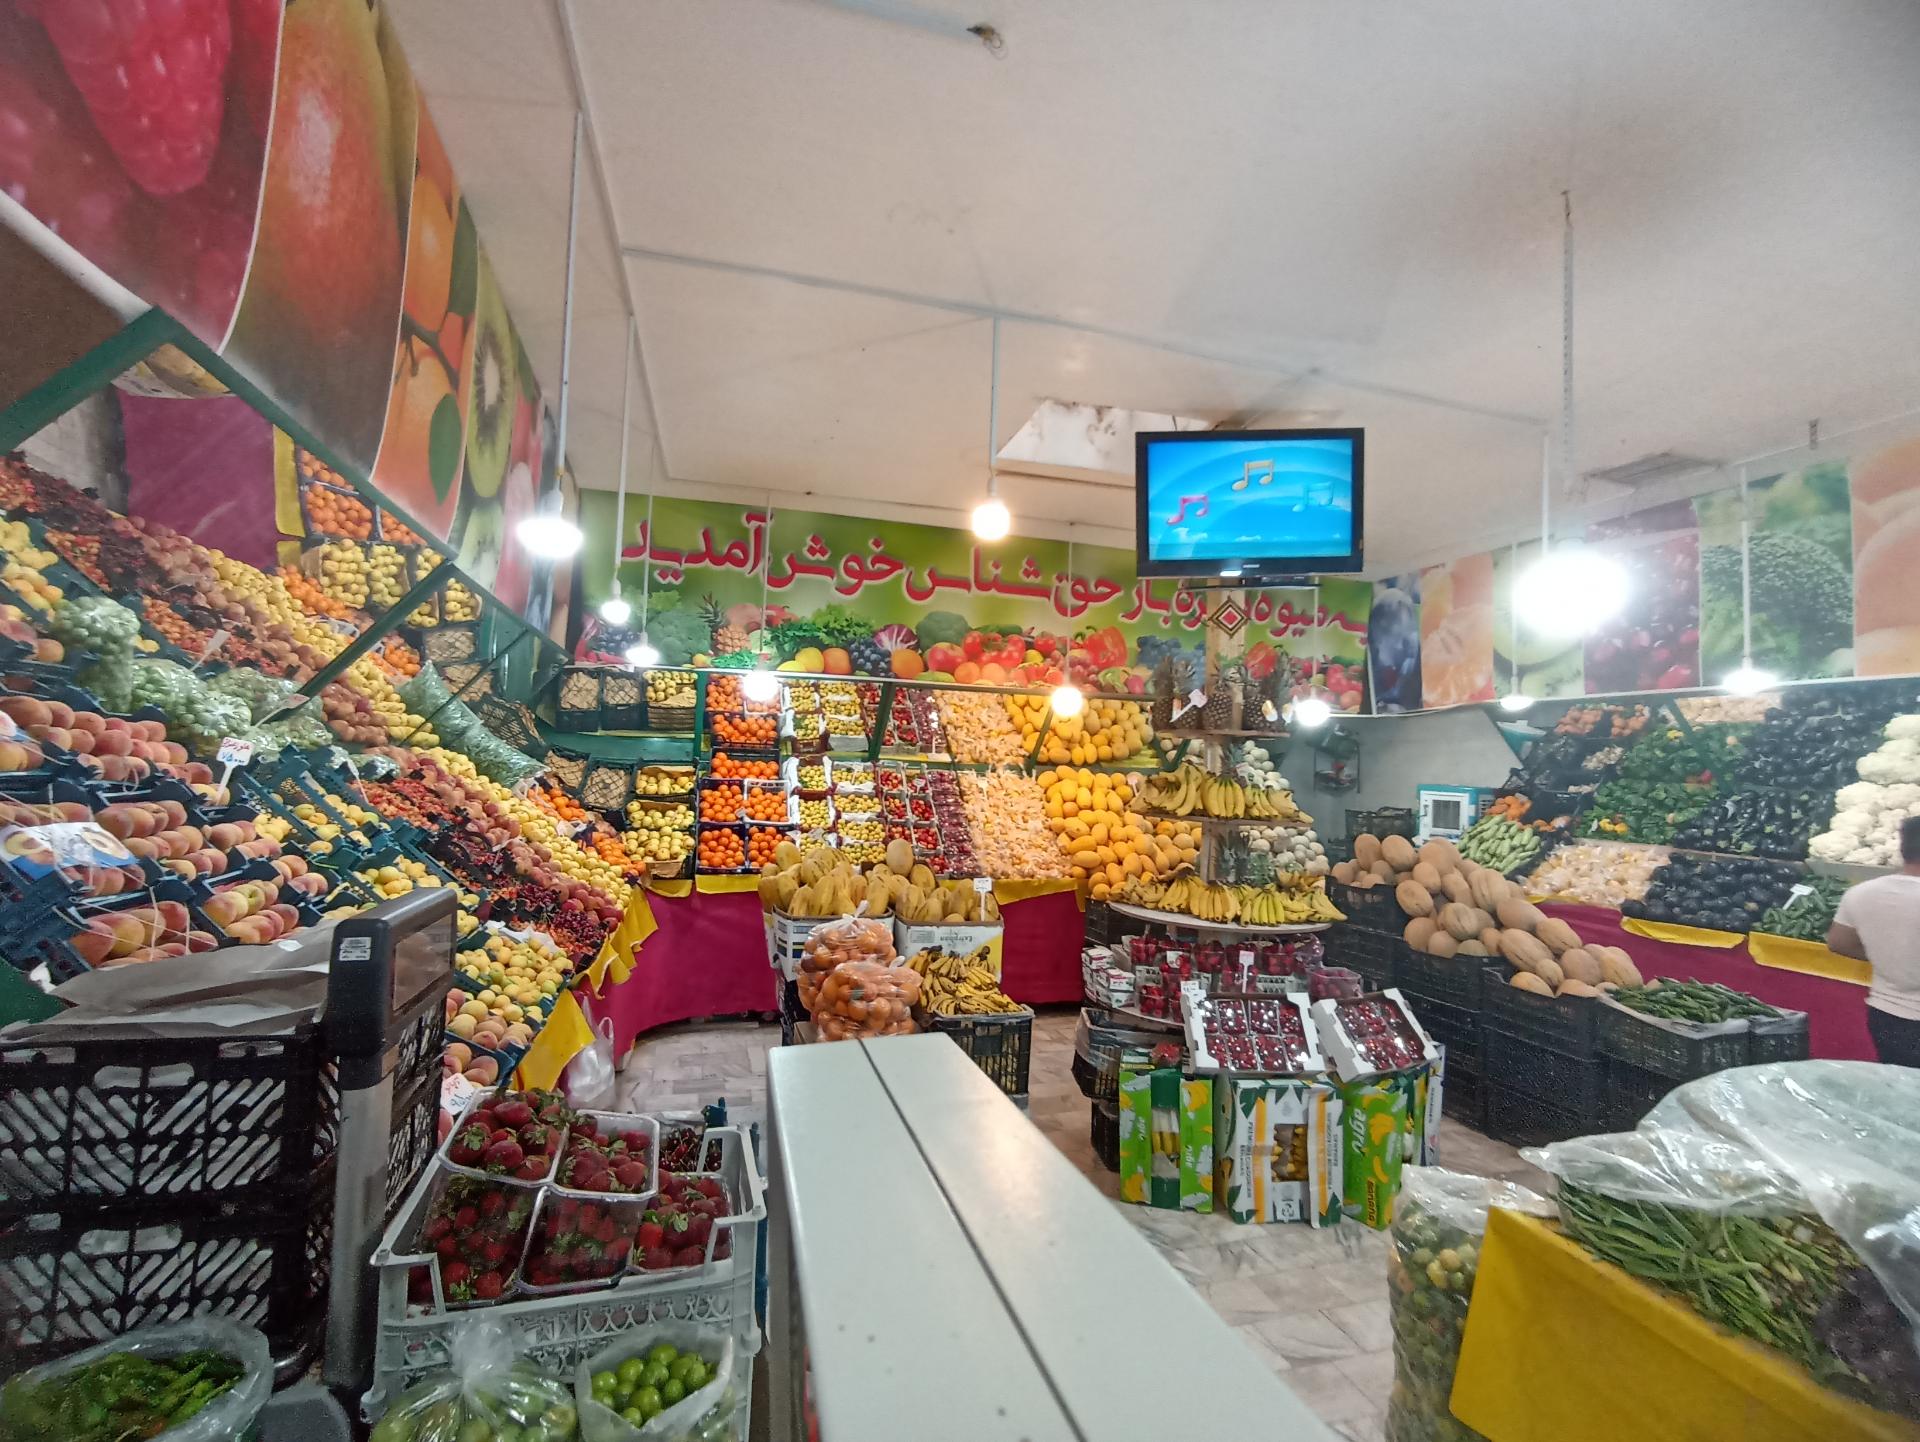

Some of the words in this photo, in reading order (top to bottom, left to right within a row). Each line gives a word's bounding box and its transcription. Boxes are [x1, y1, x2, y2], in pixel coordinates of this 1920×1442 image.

[621, 512, 773, 584] آمدید
[765, 534, 904, 596] خوش
[905, 544, 1051, 601] شناس
[1054, 573, 1121, 618] حق
[1255, 590, 1328, 637] میوه
